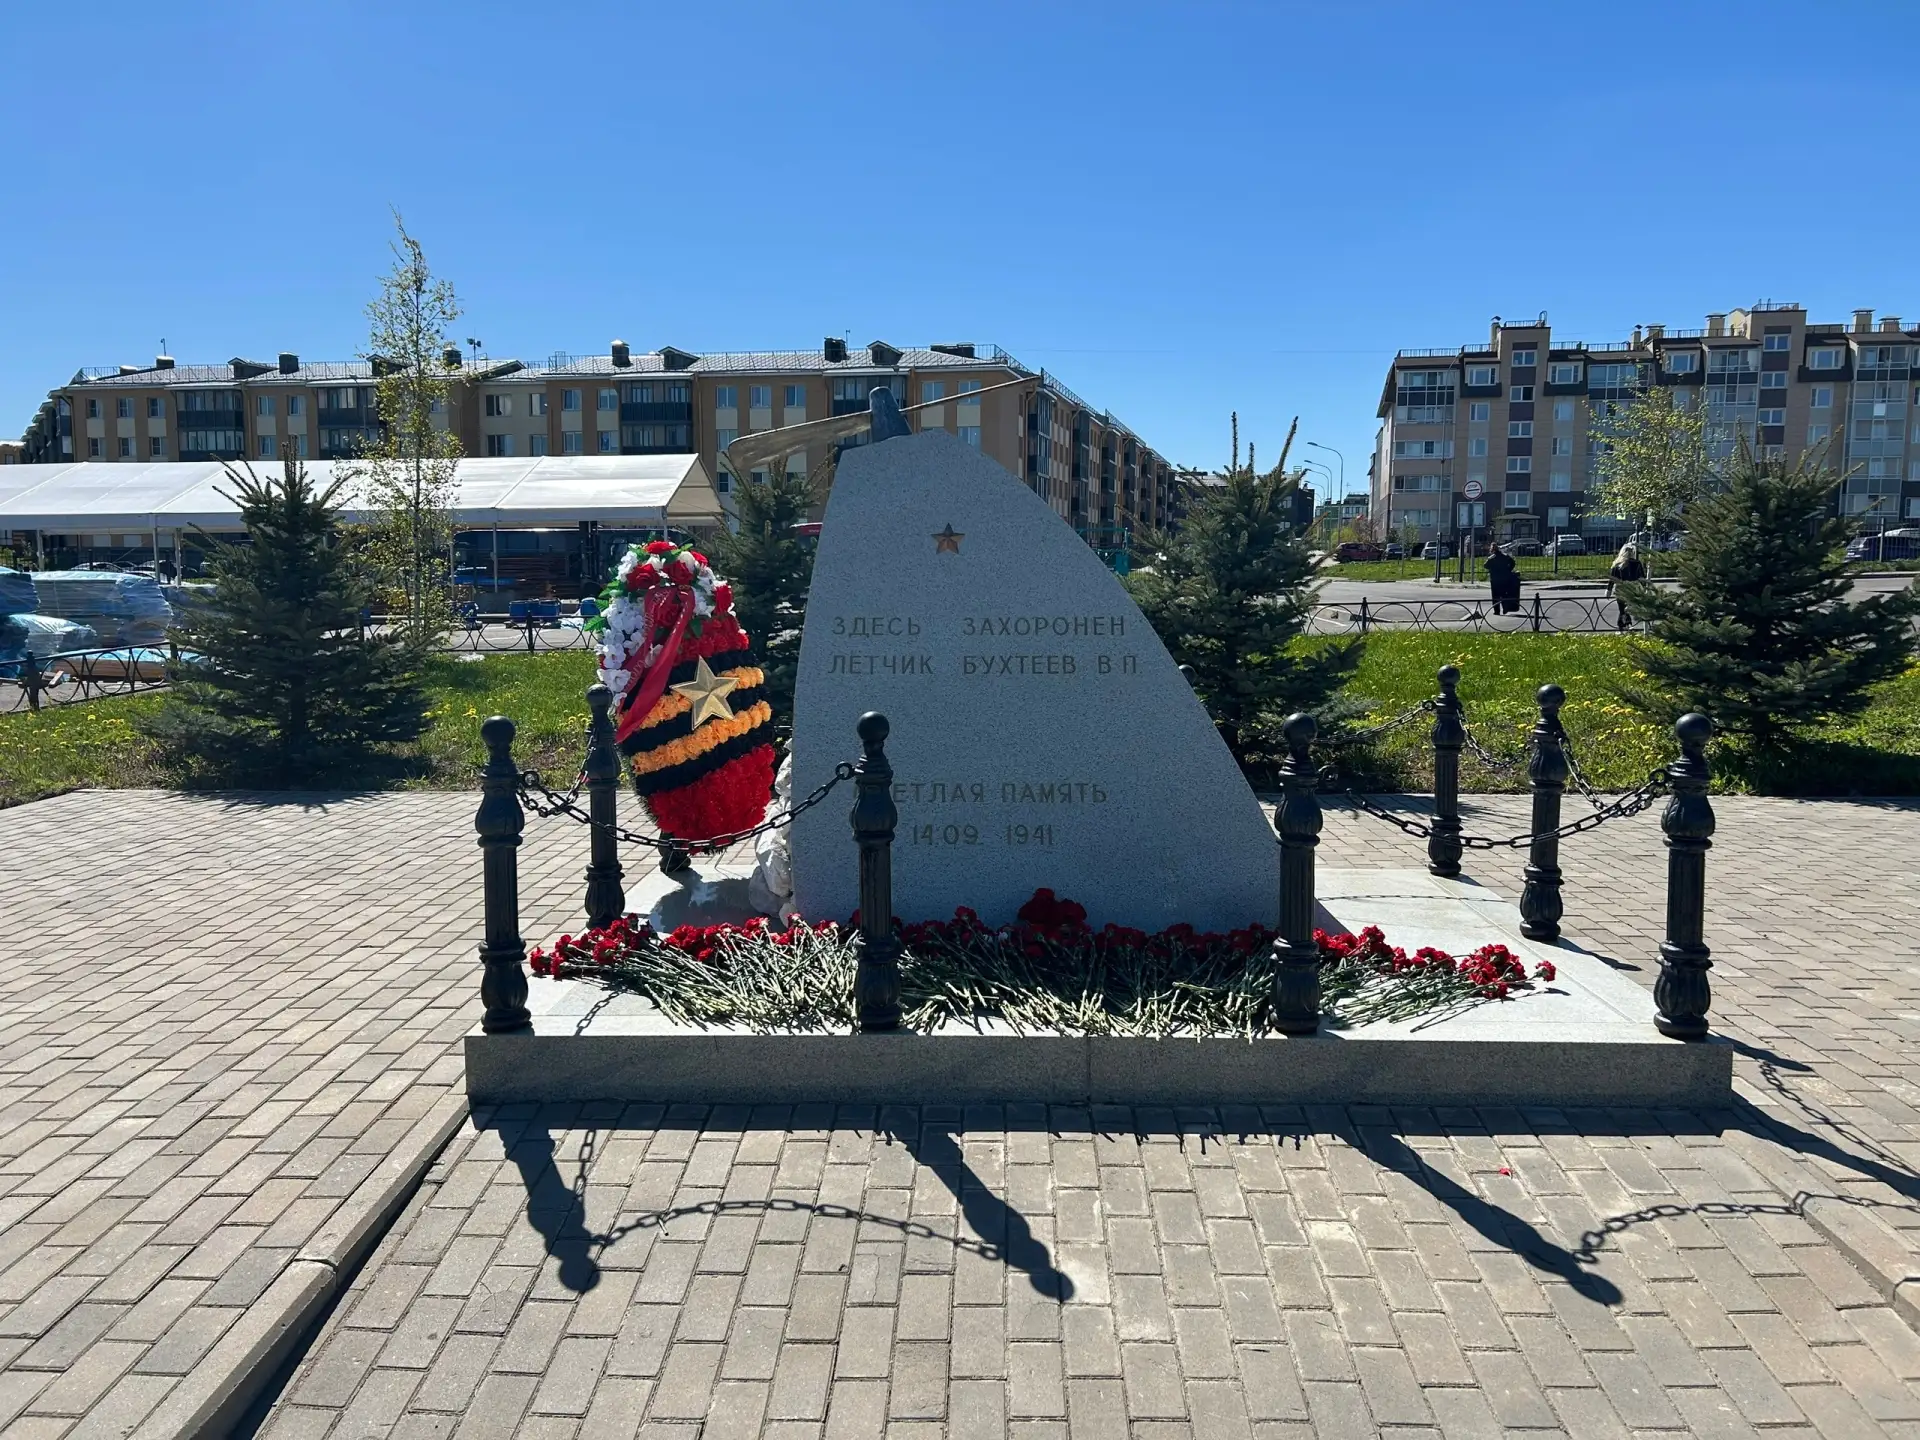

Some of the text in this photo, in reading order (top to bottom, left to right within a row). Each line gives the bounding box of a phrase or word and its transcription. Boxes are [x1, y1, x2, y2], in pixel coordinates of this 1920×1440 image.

[832, 616, 1126, 638] ЗДЕСЬ ЗАХОРОНЕН
[827, 655, 934, 675] ЛЕТЧИК
[963, 655, 1077, 675] БУХТЕЕВ
[853, 783, 1108, 804] ЕТЛАЯ ПАМЯТЬ
[1006, 824, 1053, 845] 1941
